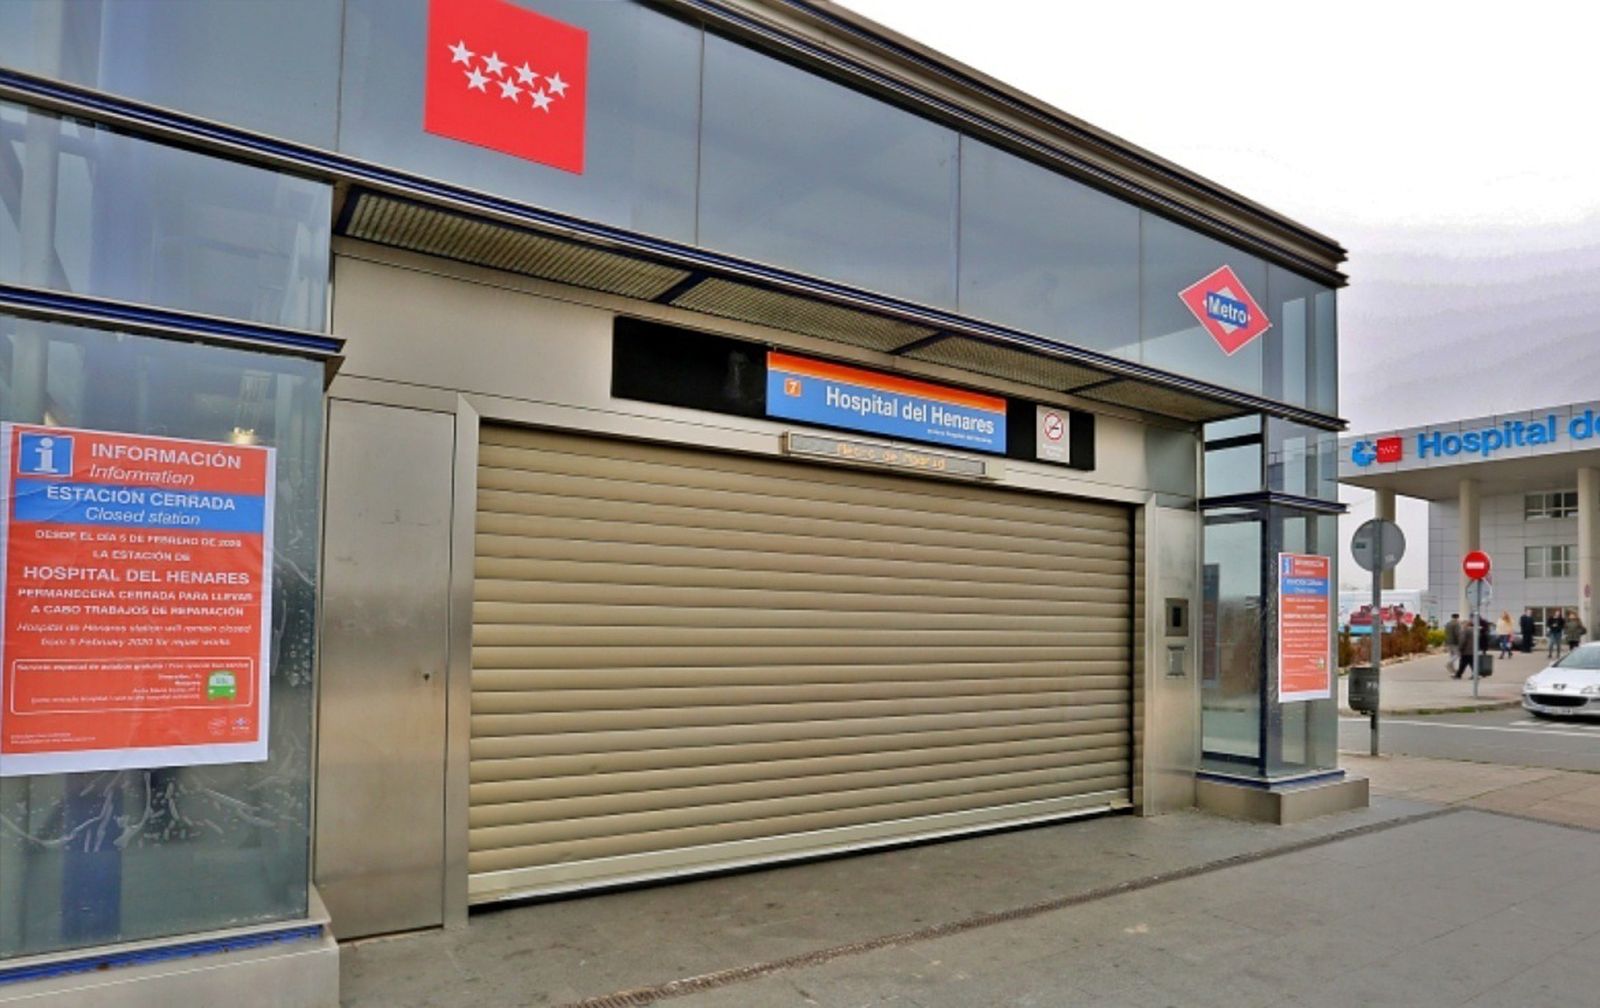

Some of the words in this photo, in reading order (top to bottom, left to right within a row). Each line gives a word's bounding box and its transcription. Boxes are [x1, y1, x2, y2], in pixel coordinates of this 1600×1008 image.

[1208, 295, 1247, 324] Metro
[788, 380, 799, 395] 7
[825, 384, 898, 418] Hospital
[902, 398, 927, 423] del
[930, 405, 995, 435] Henares
[1416, 414, 1557, 459] Hospital
[91, 443, 242, 470] INFORMACIÓN
[89, 464, 195, 485] Information
[47, 485, 145, 505] ESTACIÓN
[150, 492, 236, 511] CERRADA
[85, 506, 144, 524] Closed
[148, 512, 201, 526] station
[129, 534, 144, 543] DE
[23, 565, 120, 582] HOSPITAL
[126, 568, 162, 583] DEL
[166, 570, 250, 585] HENARES
[118, 590, 176, 601] CERRADA
[179, 591, 209, 601] PARA
[31, 605, 41, 614] A
[83, 605, 149, 616] TRABAJOS
